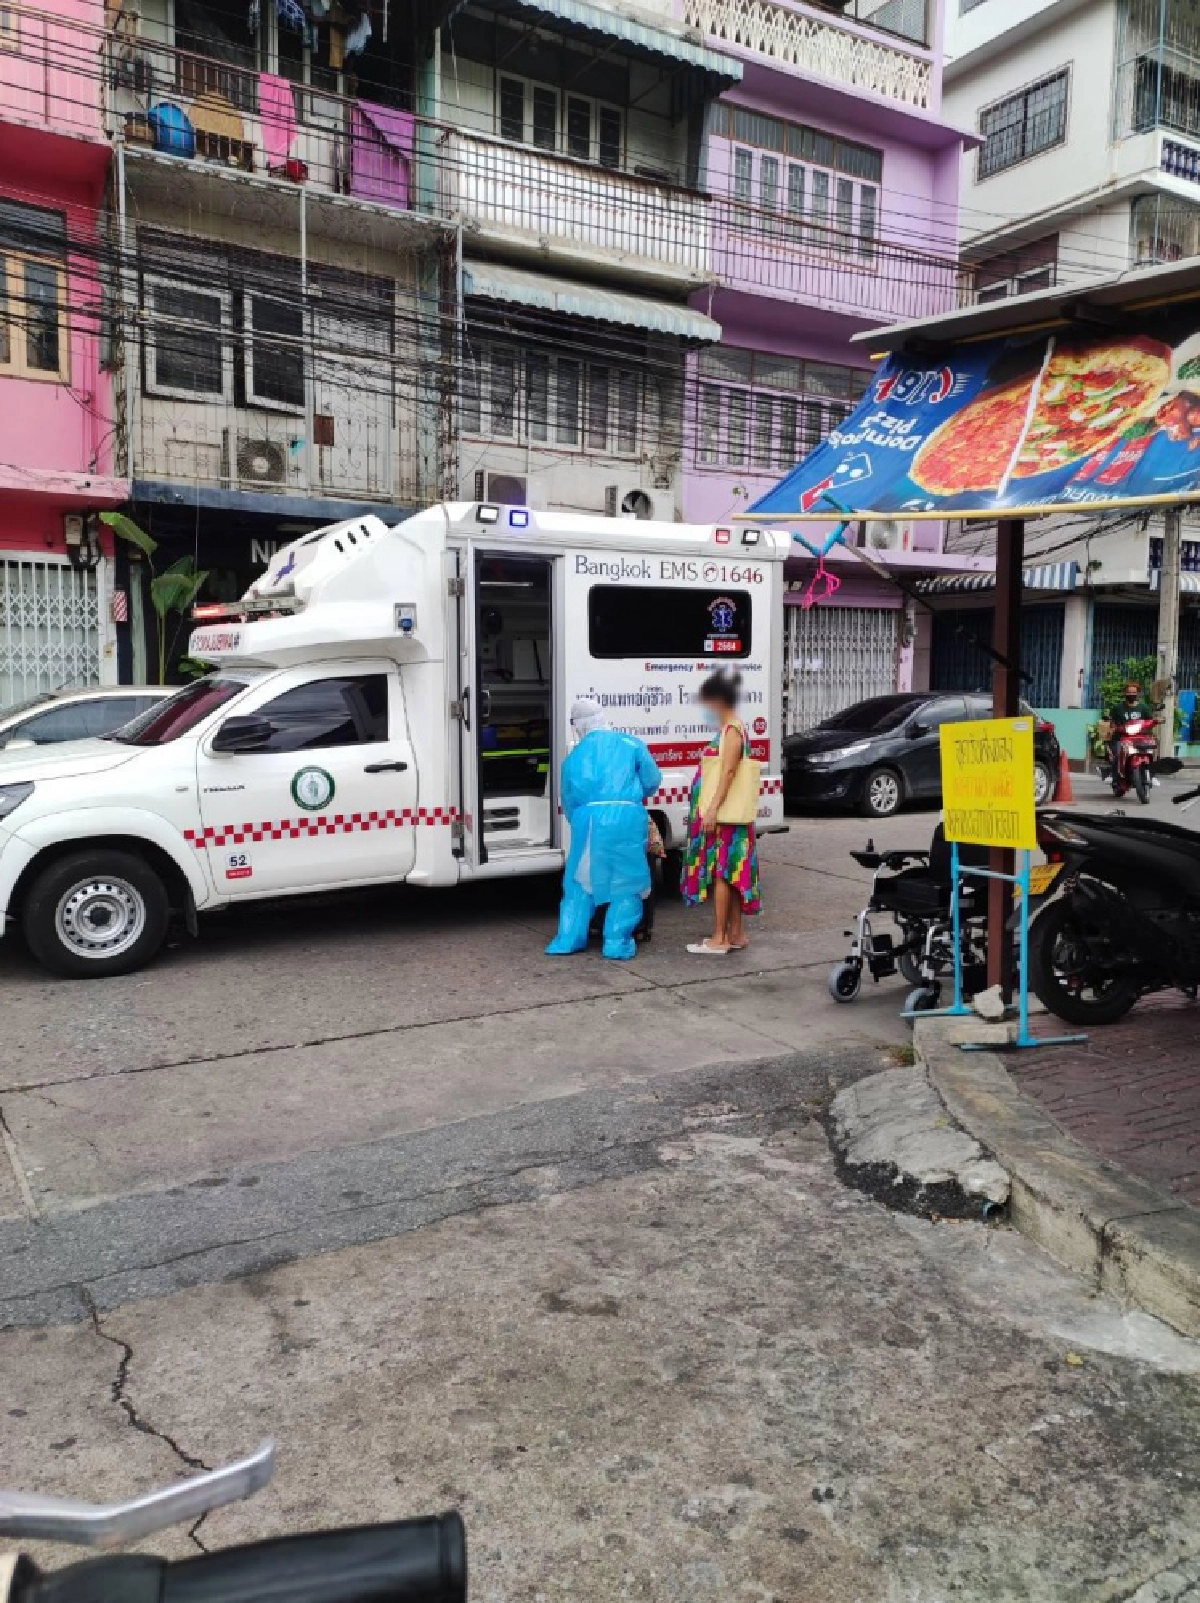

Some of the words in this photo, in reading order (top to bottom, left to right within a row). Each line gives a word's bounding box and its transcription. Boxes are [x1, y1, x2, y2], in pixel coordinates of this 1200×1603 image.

[575, 554, 651, 582] Bangkok
[660, 561, 699, 582] EMS
[721, 565, 764, 585] 1646
[644, 662, 693, 673] Emergency
[229, 854, 248, 867] 52
